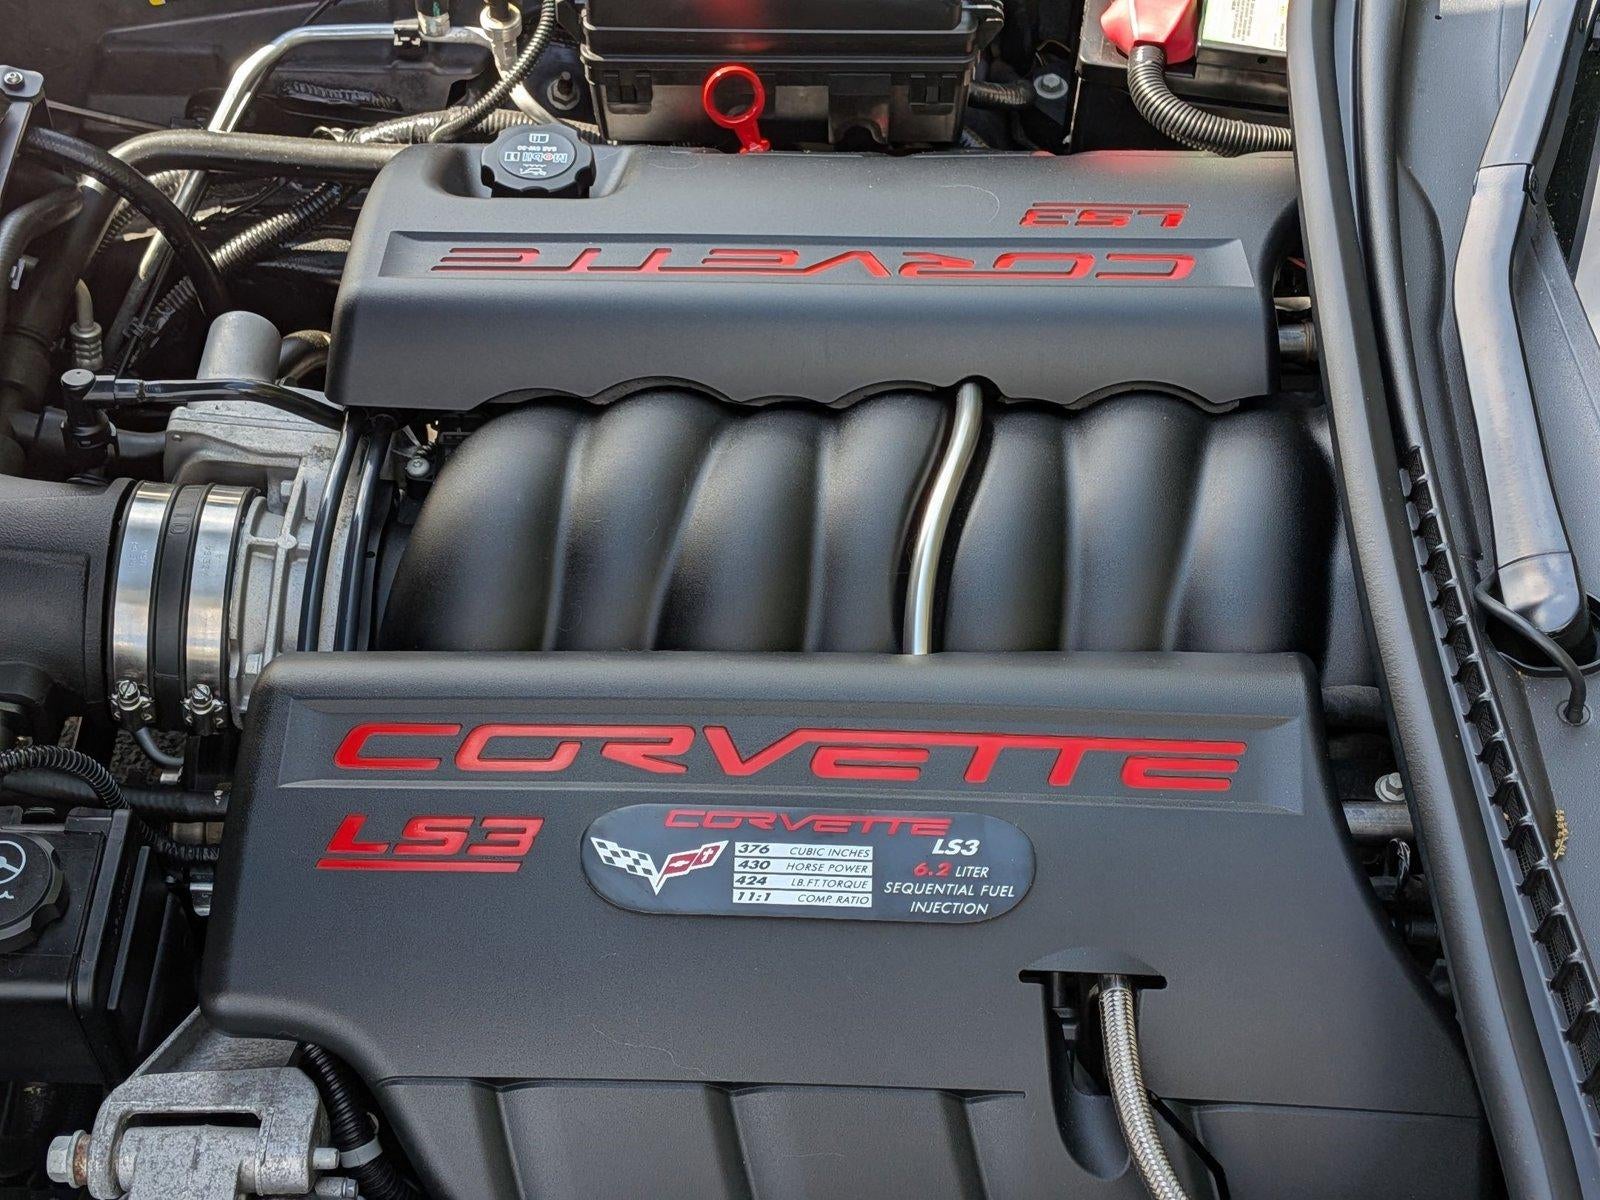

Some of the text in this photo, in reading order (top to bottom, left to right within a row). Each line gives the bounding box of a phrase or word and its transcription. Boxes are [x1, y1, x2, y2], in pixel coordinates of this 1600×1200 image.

[522, 152, 568, 163] Mobil
[1018, 202, 1189, 229] LS3
[430, 246, 1197, 280] CORVETTE
[333, 722, 1248, 792] CORVETTE
[664, 809, 953, 836] CORVETTE
[325, 813, 546, 856] LS3
[737, 843, 871, 858] 376 CUBIC INCHES
[931, 838, 981, 856] LS3
[737, 859, 868, 873] 430 HORSE POWER
[913, 861, 990, 878] 6.2 LITER
[734, 875, 768, 886] 424
[737, 891, 772, 902] 11:1
[835, 895, 870, 905] RATIO
[883, 881, 1016, 898] SEQUENTIAL FUEL
[909, 901, 989, 915] INJECTION
